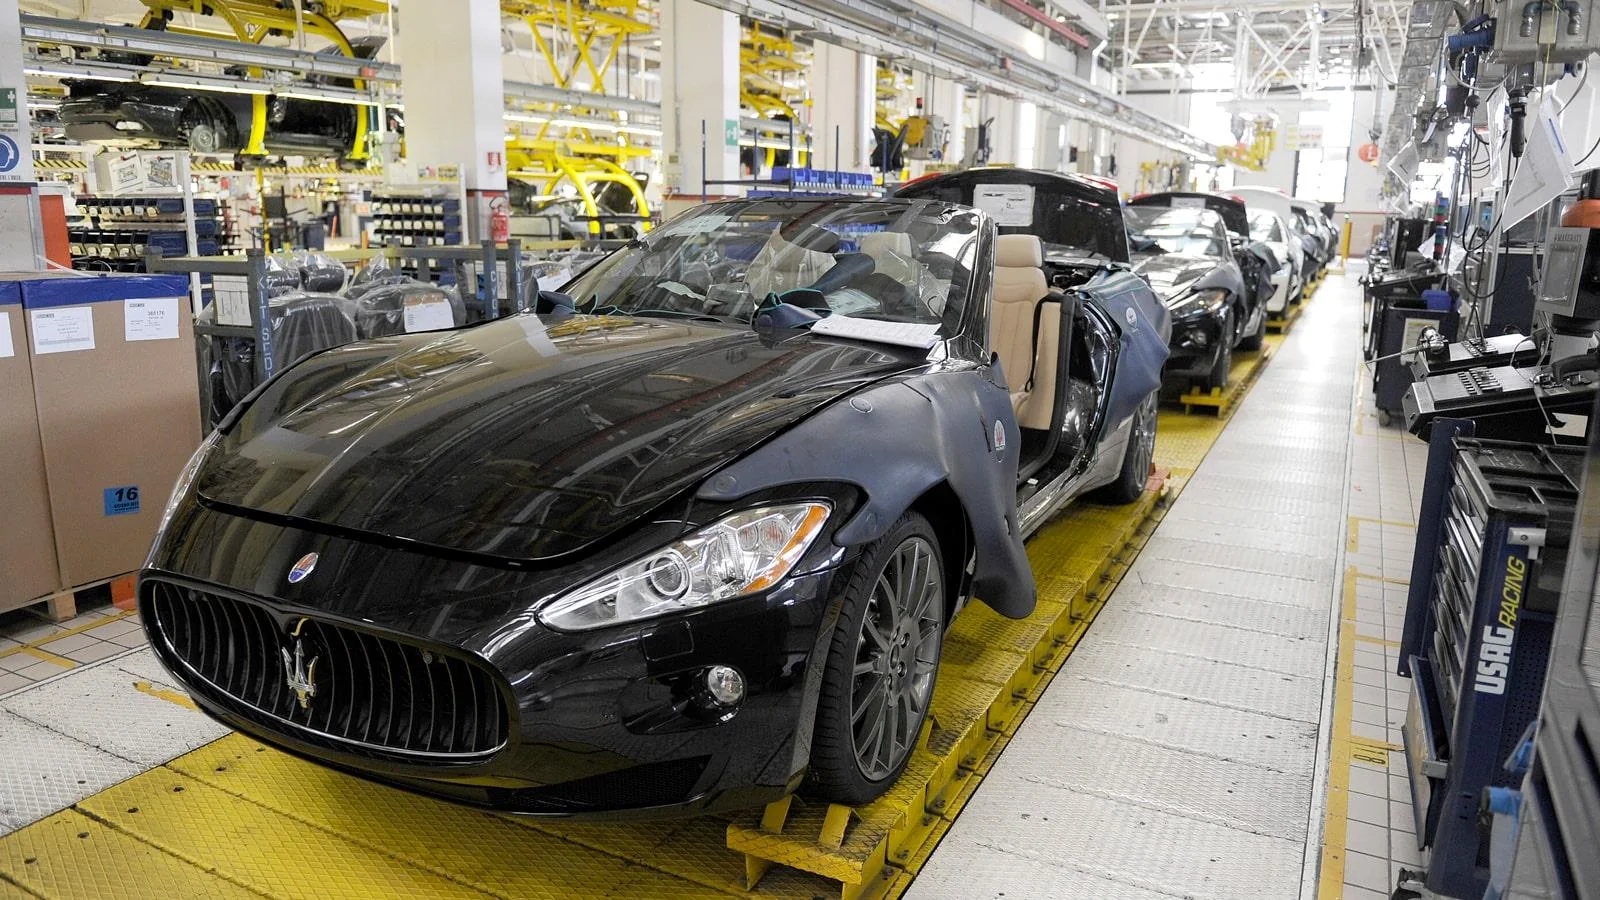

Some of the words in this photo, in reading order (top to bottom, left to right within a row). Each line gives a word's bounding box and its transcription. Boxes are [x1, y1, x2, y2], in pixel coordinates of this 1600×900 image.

[257, 276, 267, 319] KIT
[115, 486, 139, 502] 16
[1474, 625, 1515, 695] USAG
[1498, 555, 1526, 629] RACING
